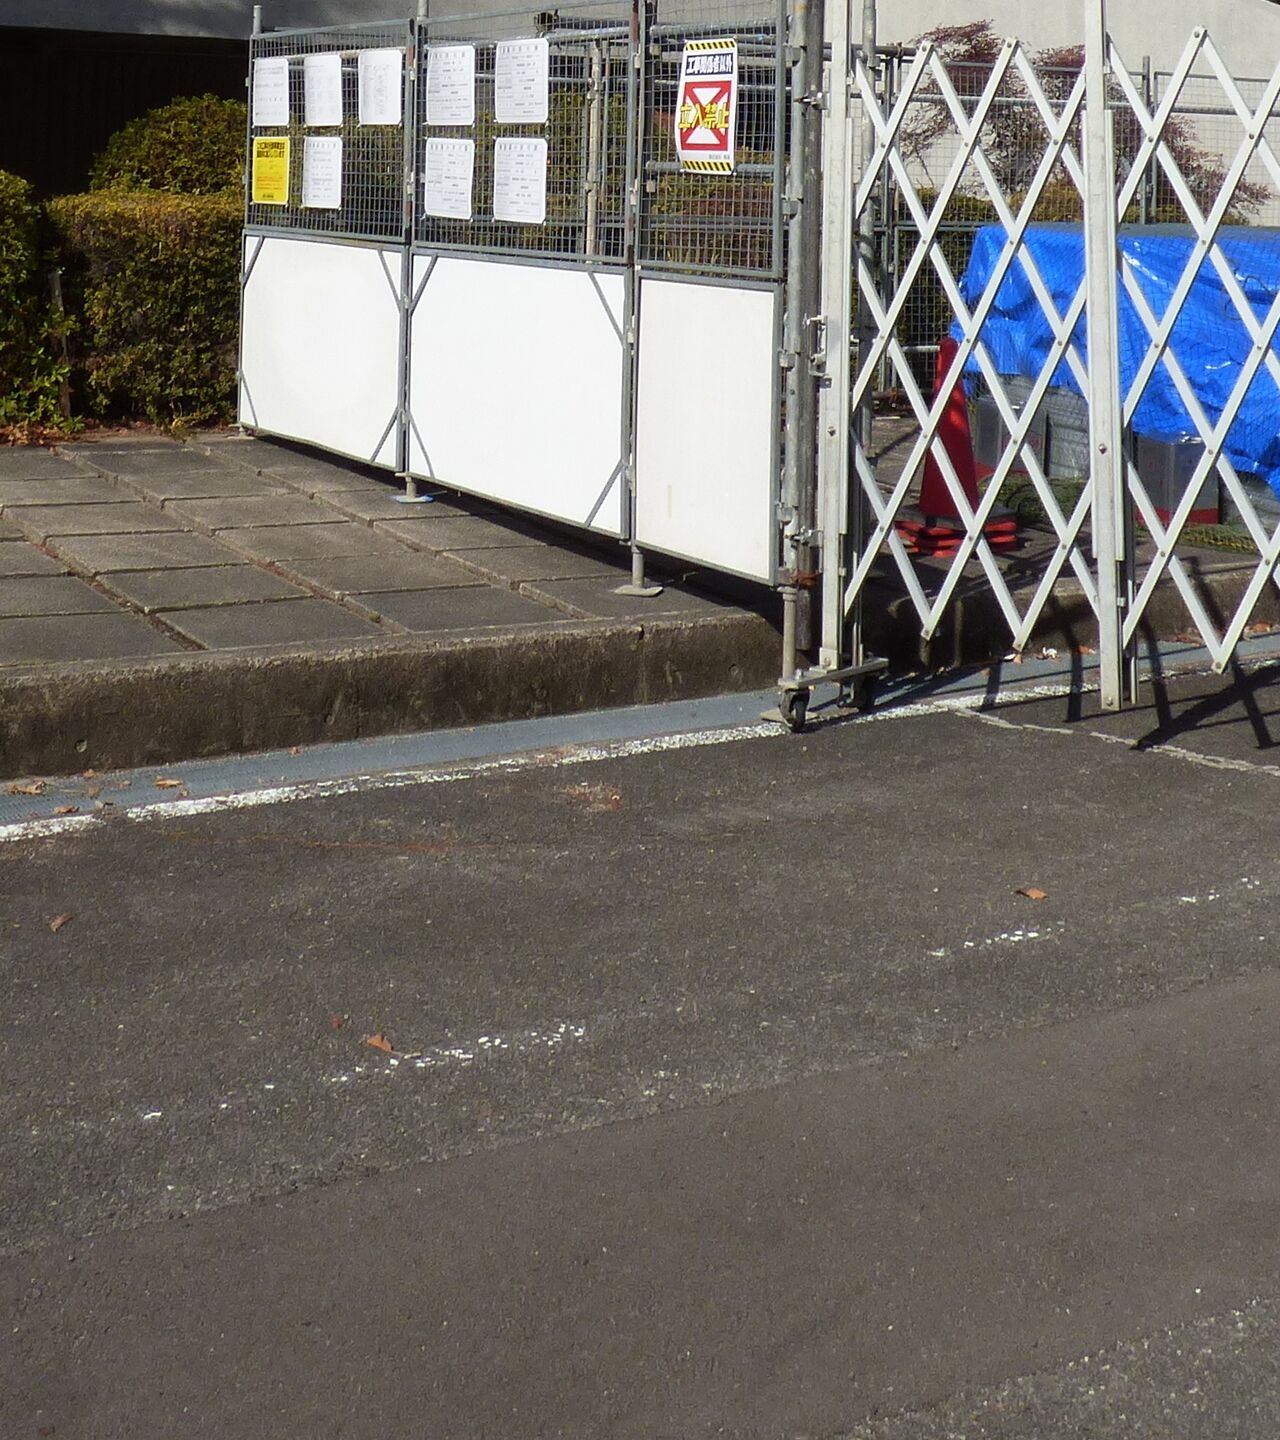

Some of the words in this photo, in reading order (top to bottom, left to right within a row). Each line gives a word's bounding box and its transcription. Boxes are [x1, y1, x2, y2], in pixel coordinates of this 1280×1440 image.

[686, 54, 732, 74] 工事関係者以外
[679, 103, 729, 128] 立入禁止
